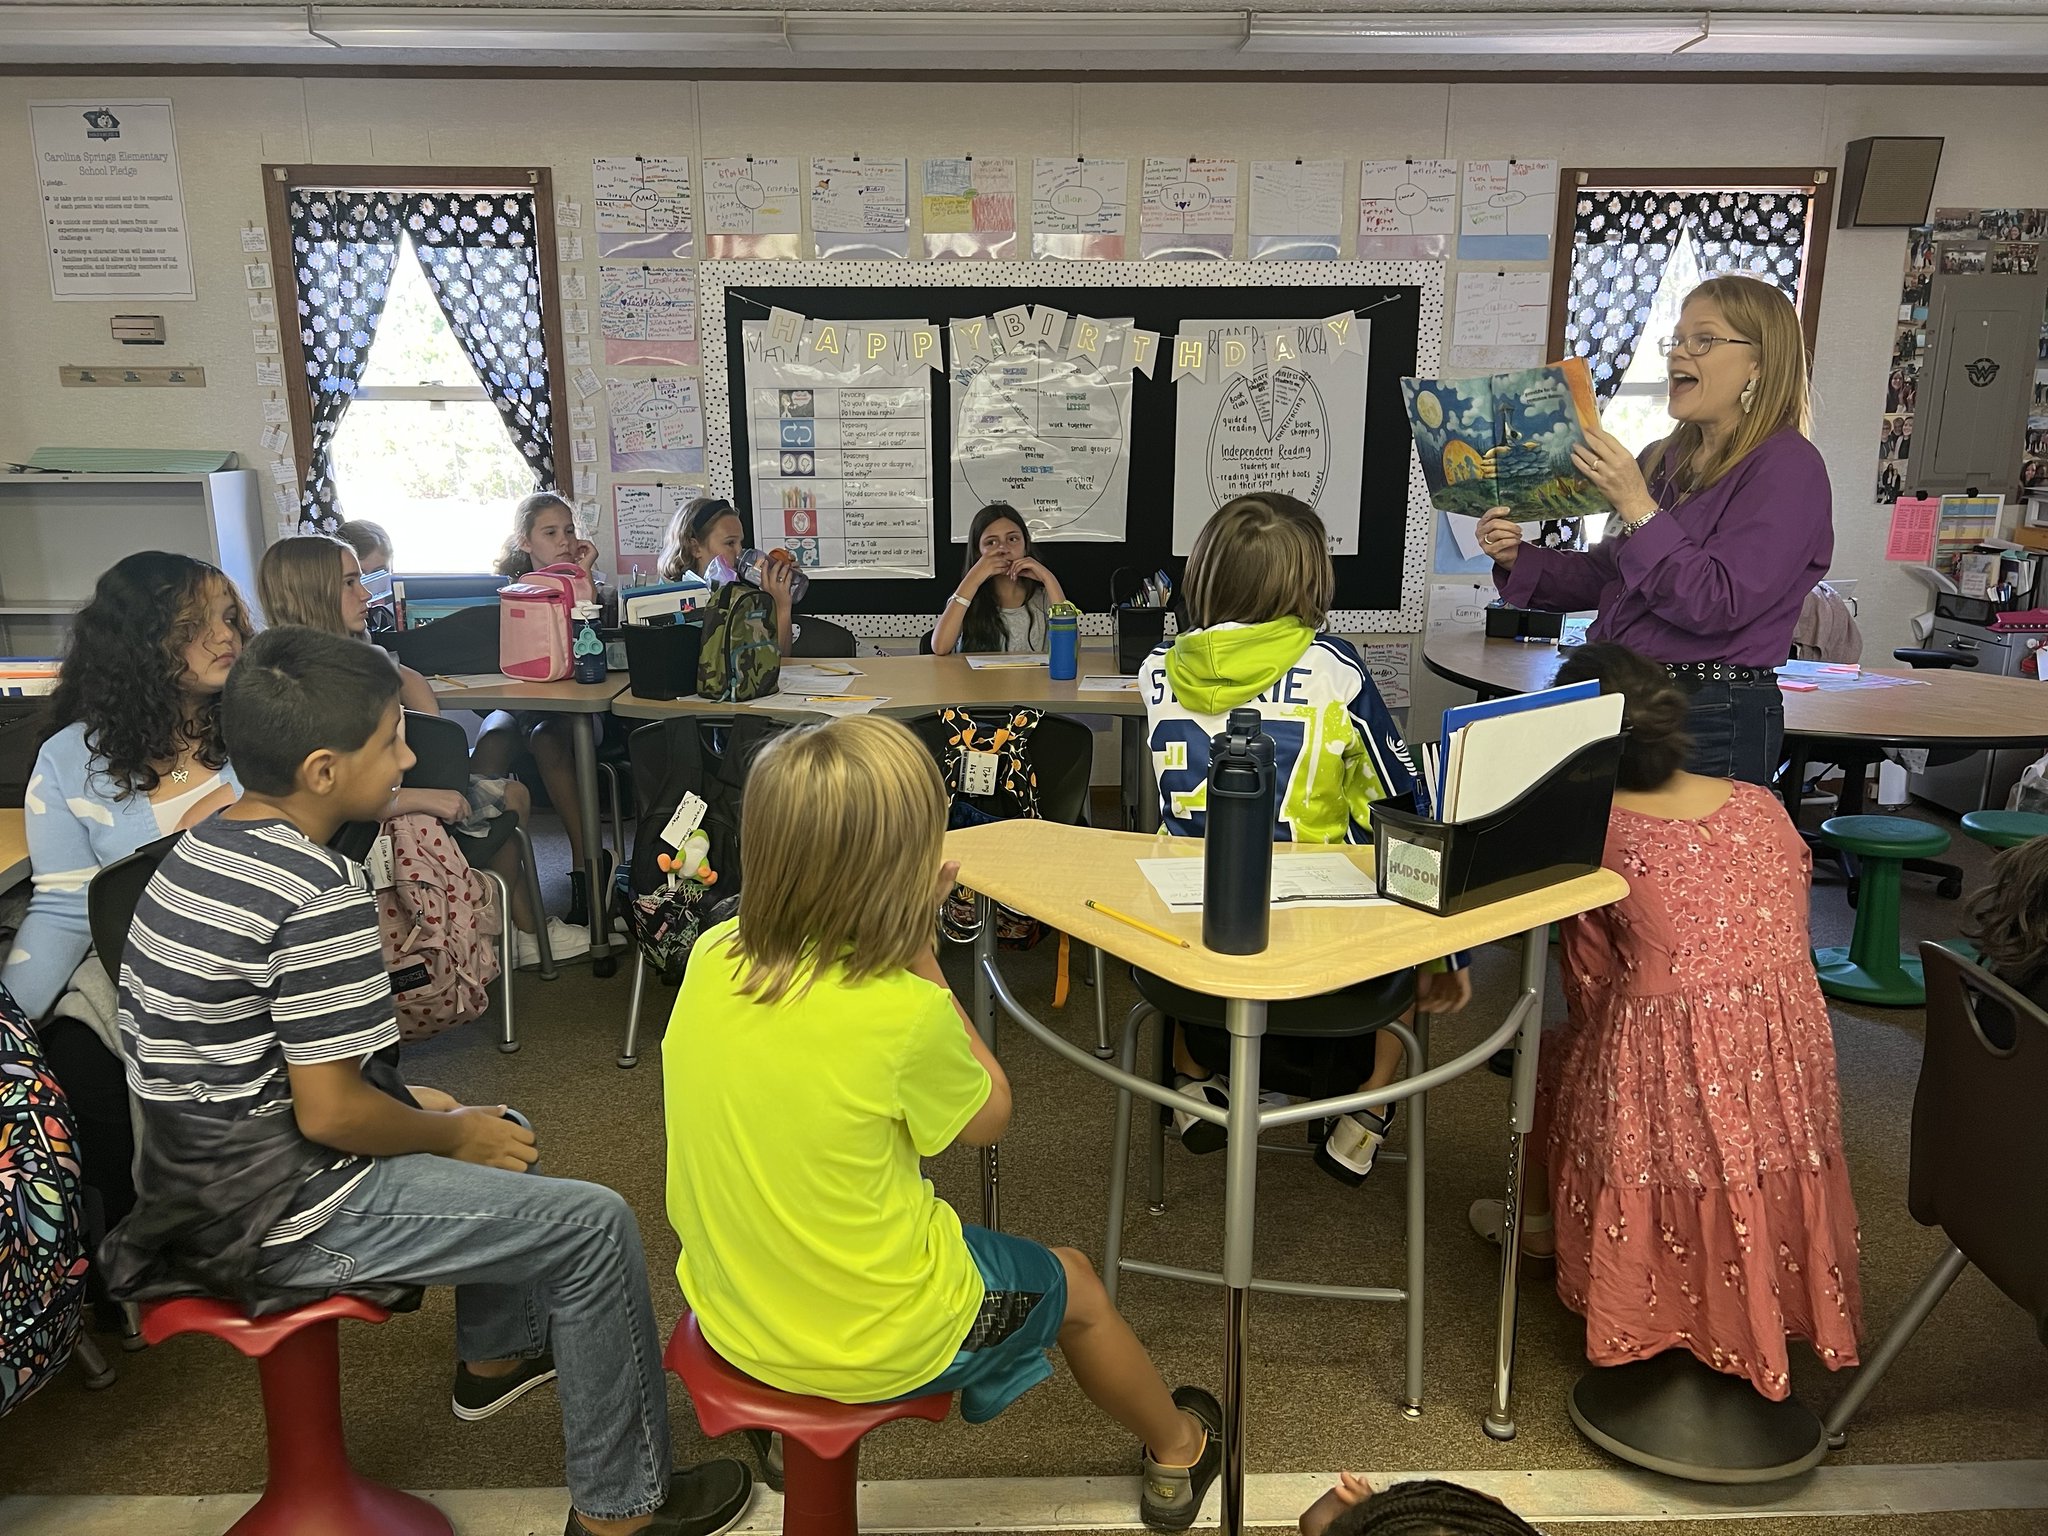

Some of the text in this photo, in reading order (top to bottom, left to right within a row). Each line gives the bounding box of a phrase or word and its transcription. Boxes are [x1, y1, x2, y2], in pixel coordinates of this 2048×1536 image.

[44, 152, 168, 163] Carolina Springs Elementary
[79, 166, 138, 177] School Pledge
[772, 314, 982, 359] HAPPY
[1003, 313, 1350, 368] BIRTHDAY
[1229, 392, 1244, 404] book
[1232, 399, 1248, 410] clubs
[1222, 415, 1248, 426] guided
[1294, 420, 1312, 428] book
[1228, 424, 1257, 434] reading
[1290, 426, 1320, 440] shopping
[1090, 446, 1112, 454] groups
[1221, 444, 1312, 460] Independent Reading
[844, 452, 870, 460] Reasoning
[865, 462, 880, 470] agree
[1240, 462, 1268, 470] students
[1252, 472, 1268, 480] just
[1270, 470, 1290, 480] right
[1292, 470, 1310, 478] books
[1240, 480, 1256, 490] their
[1258, 480, 1273, 490] spot
[1033, 498, 1059, 506] learning
[1390, 860, 1438, 888] HUDSON
